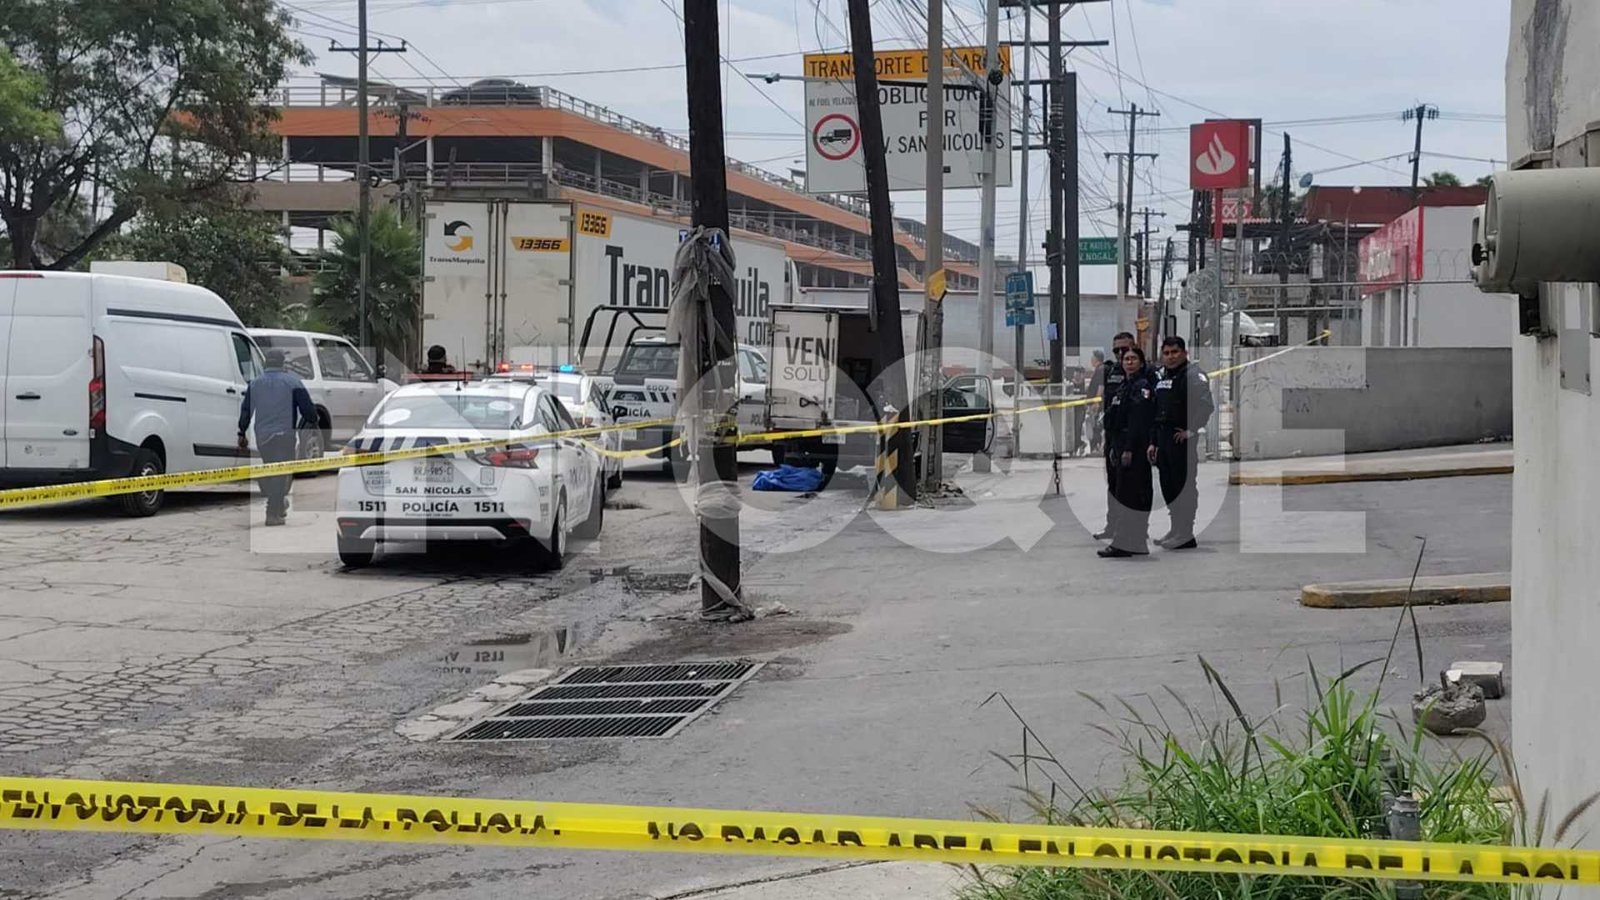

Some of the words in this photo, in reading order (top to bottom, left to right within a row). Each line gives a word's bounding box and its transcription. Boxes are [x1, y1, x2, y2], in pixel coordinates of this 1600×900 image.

[809, 56, 913, 77] TRANORTE
[919, 109, 956, 128] PR
[898, 135, 928, 153] SAN
[580, 213, 607, 235] 13366
[519, 238, 563, 250] 13366
[605, 244, 770, 319] Tranuila
[396, 486, 418, 494] SAN
[424, 485, 472, 495] NICOLÁS
[358, 501, 387, 512] 1511
[402, 499, 460, 512] POLICÍA
[474, 501, 504, 513] 1511
